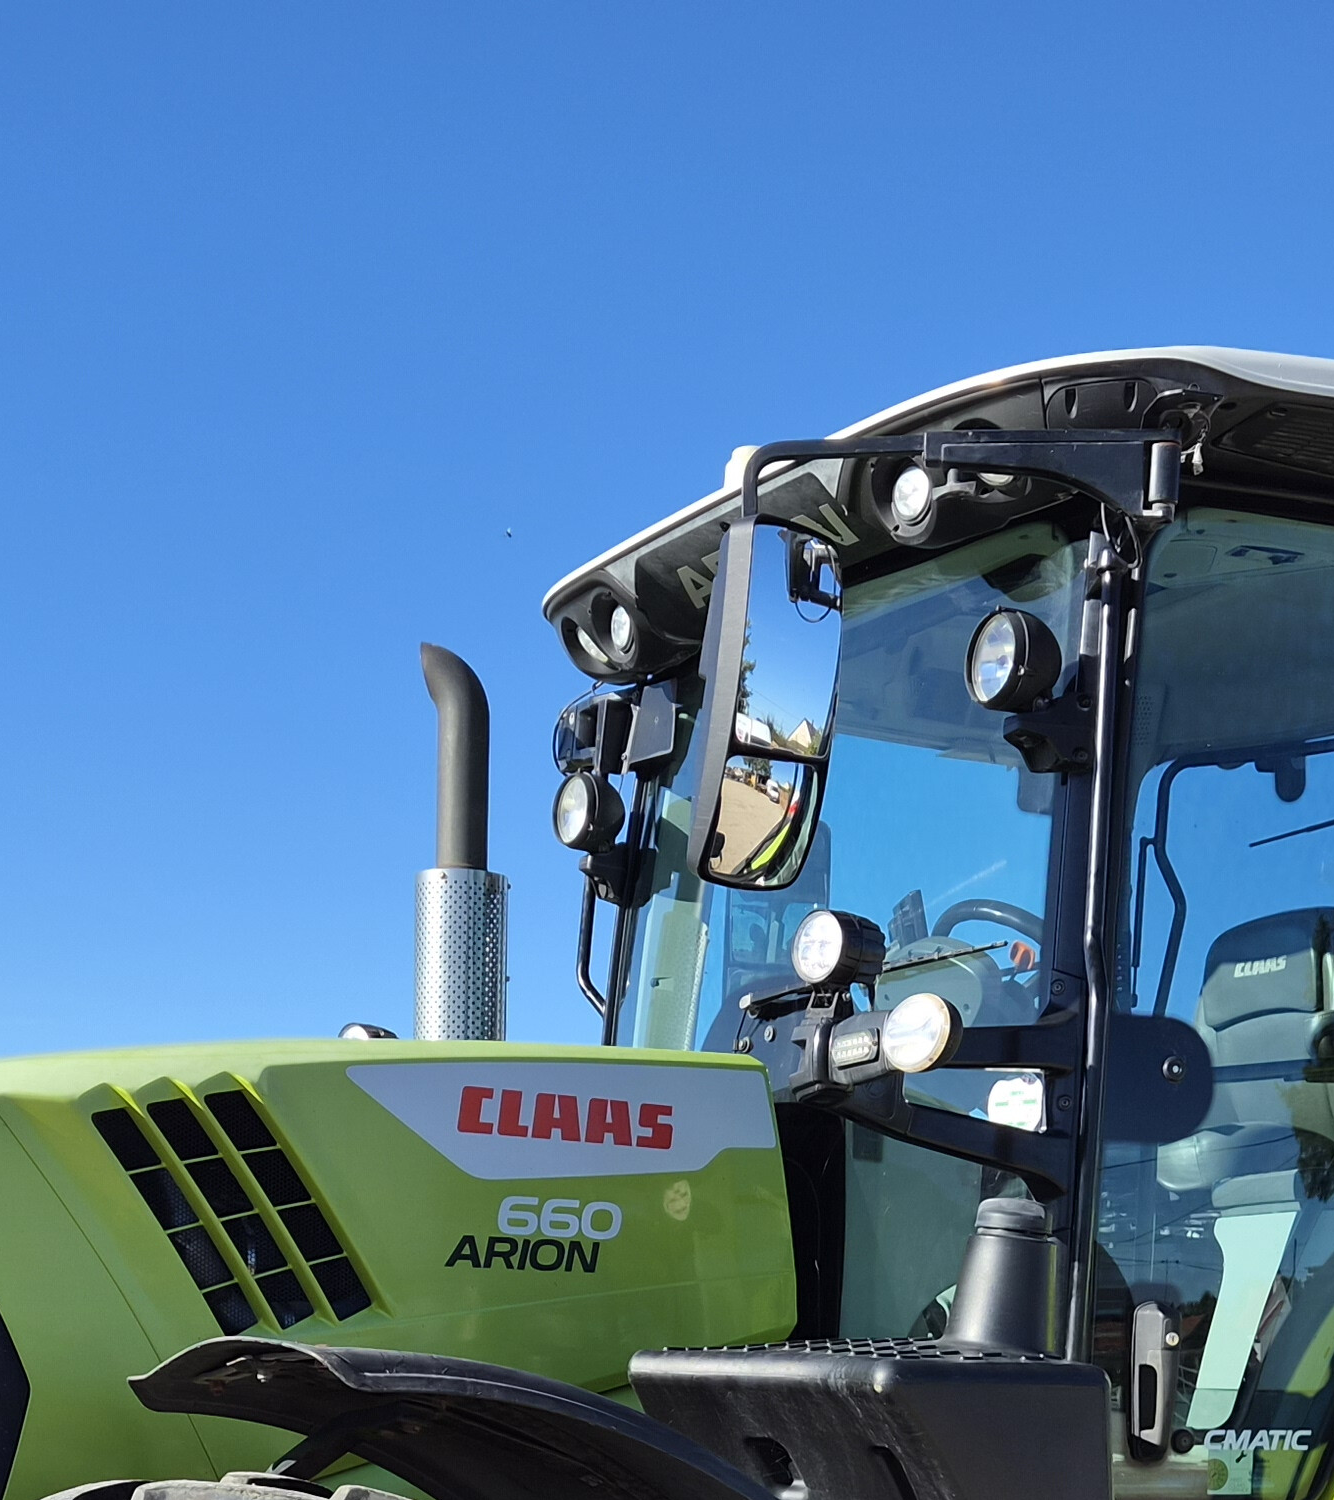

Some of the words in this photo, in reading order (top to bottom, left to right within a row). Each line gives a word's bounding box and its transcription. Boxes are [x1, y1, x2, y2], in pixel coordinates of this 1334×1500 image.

[1234, 955, 1287, 978] CLAAS
[457, 1085, 674, 1150] CLAAS
[497, 1195, 623, 1240] 660
[444, 1234, 601, 1274] ARION
[1203, 1429, 1313, 1451] CMATIC
